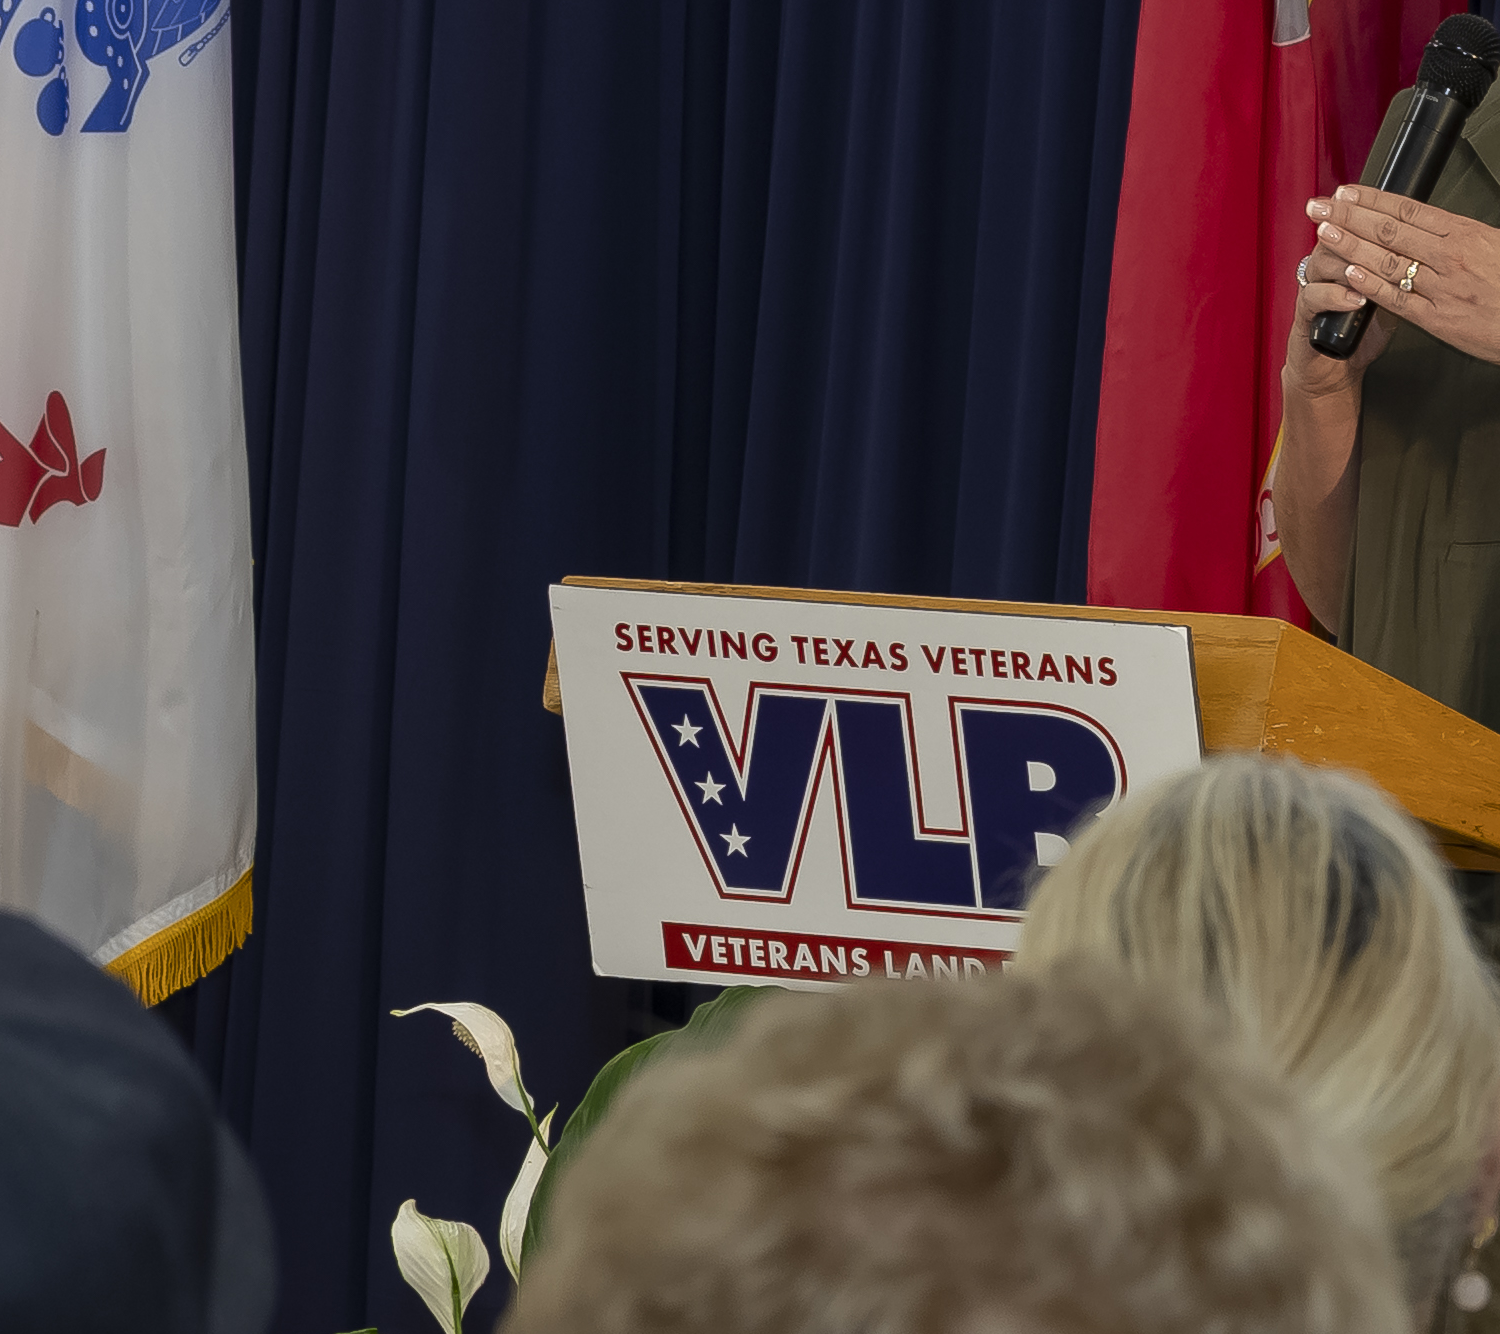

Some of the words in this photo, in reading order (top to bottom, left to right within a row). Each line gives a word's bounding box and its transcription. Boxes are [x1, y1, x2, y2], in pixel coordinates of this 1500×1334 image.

[615, 622, 778, 663] SERVING
[790, 636, 909, 672] TEXAS
[921, 644, 1119, 687] VETERANS
[620, 671, 1128, 923] VLB
[681, 932, 871, 978] VETERANS
[883, 950, 988, 983] LAND
